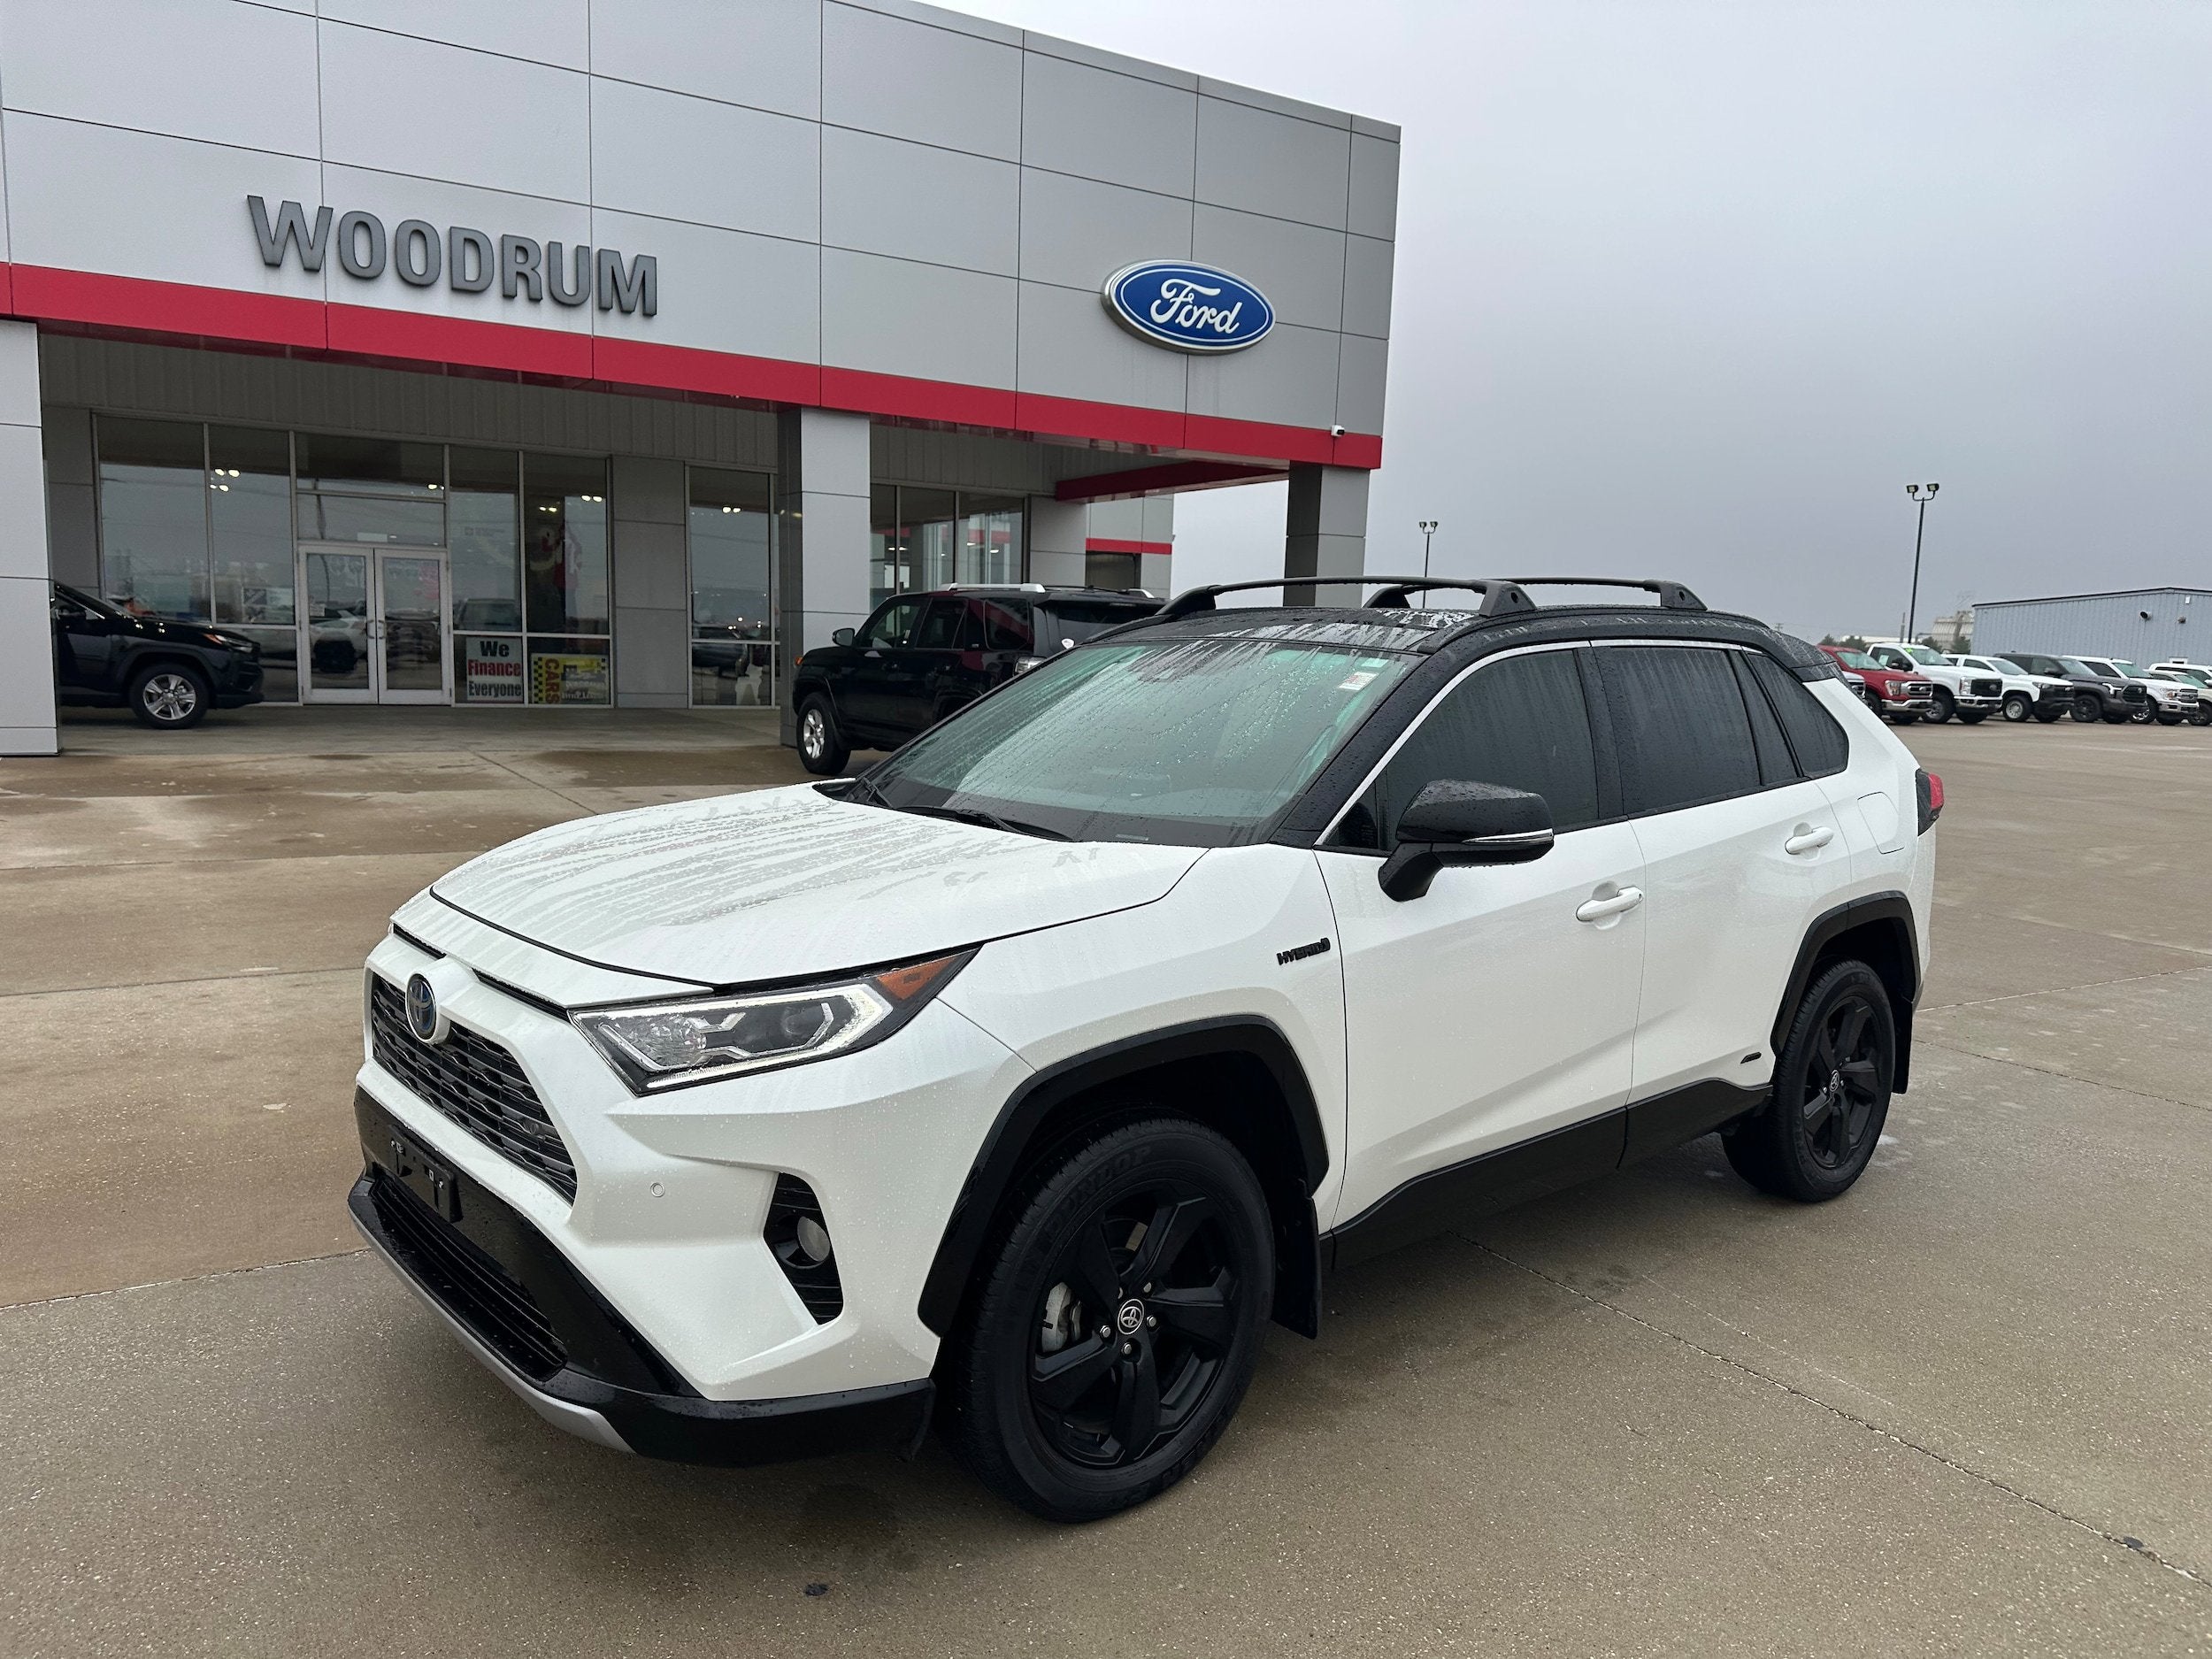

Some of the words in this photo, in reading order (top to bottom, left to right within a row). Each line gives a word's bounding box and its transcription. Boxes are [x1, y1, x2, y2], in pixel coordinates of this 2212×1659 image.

[247, 195, 657, 317] WOODRUM
[1150, 278, 1243, 334] Ford
[480, 641, 510, 657] We
[467, 659, 521, 677] Finance
[545, 658, 560, 704] CARS
[468, 680, 522, 698] Everyone
